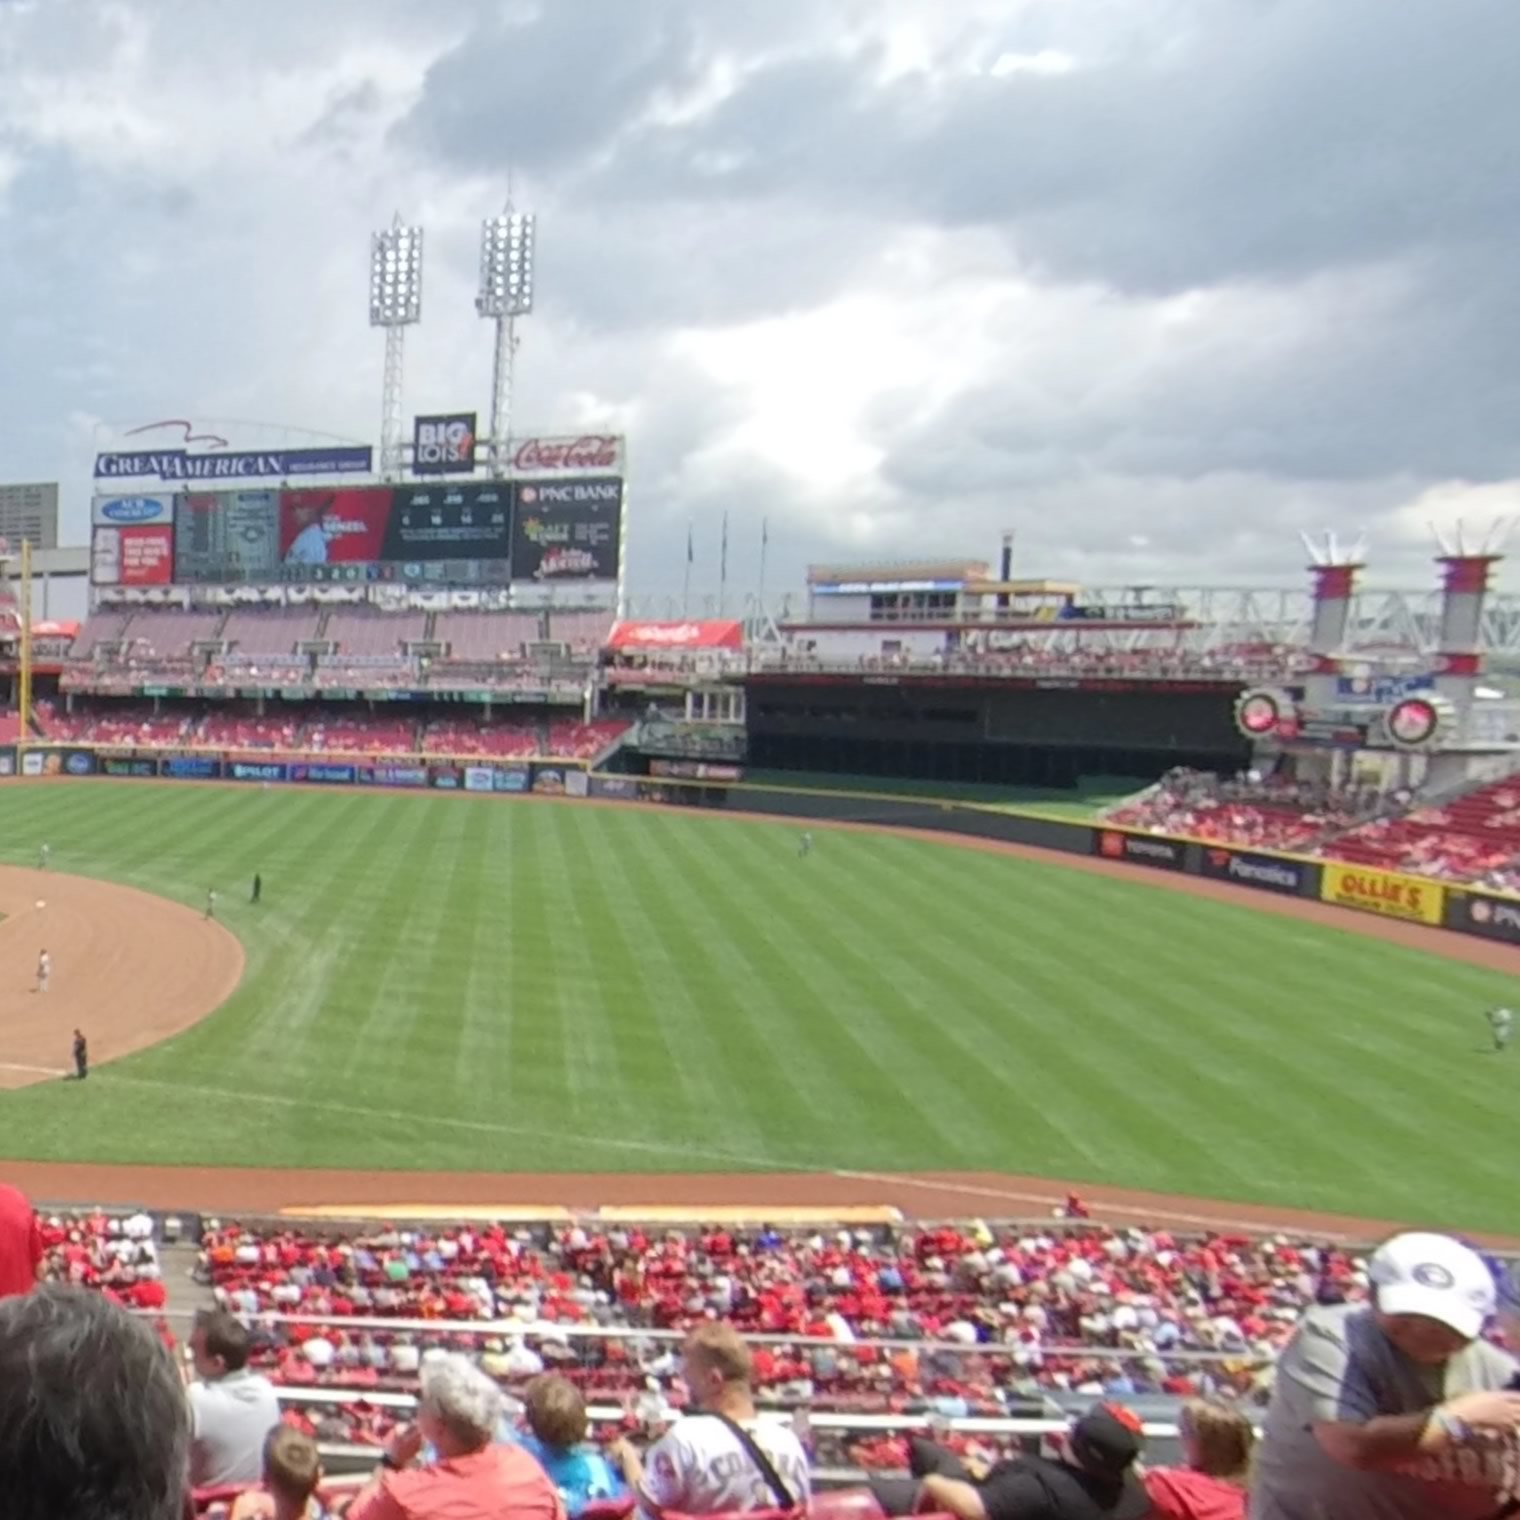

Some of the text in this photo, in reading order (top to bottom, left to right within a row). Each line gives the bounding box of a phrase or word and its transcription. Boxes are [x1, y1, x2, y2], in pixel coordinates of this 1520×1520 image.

[418, 422, 469, 446] BIG
[98, 454, 173, 475] GREAT
[166, 454, 284, 478] AMERICAN
[539, 484, 618, 501] PNC BANK
